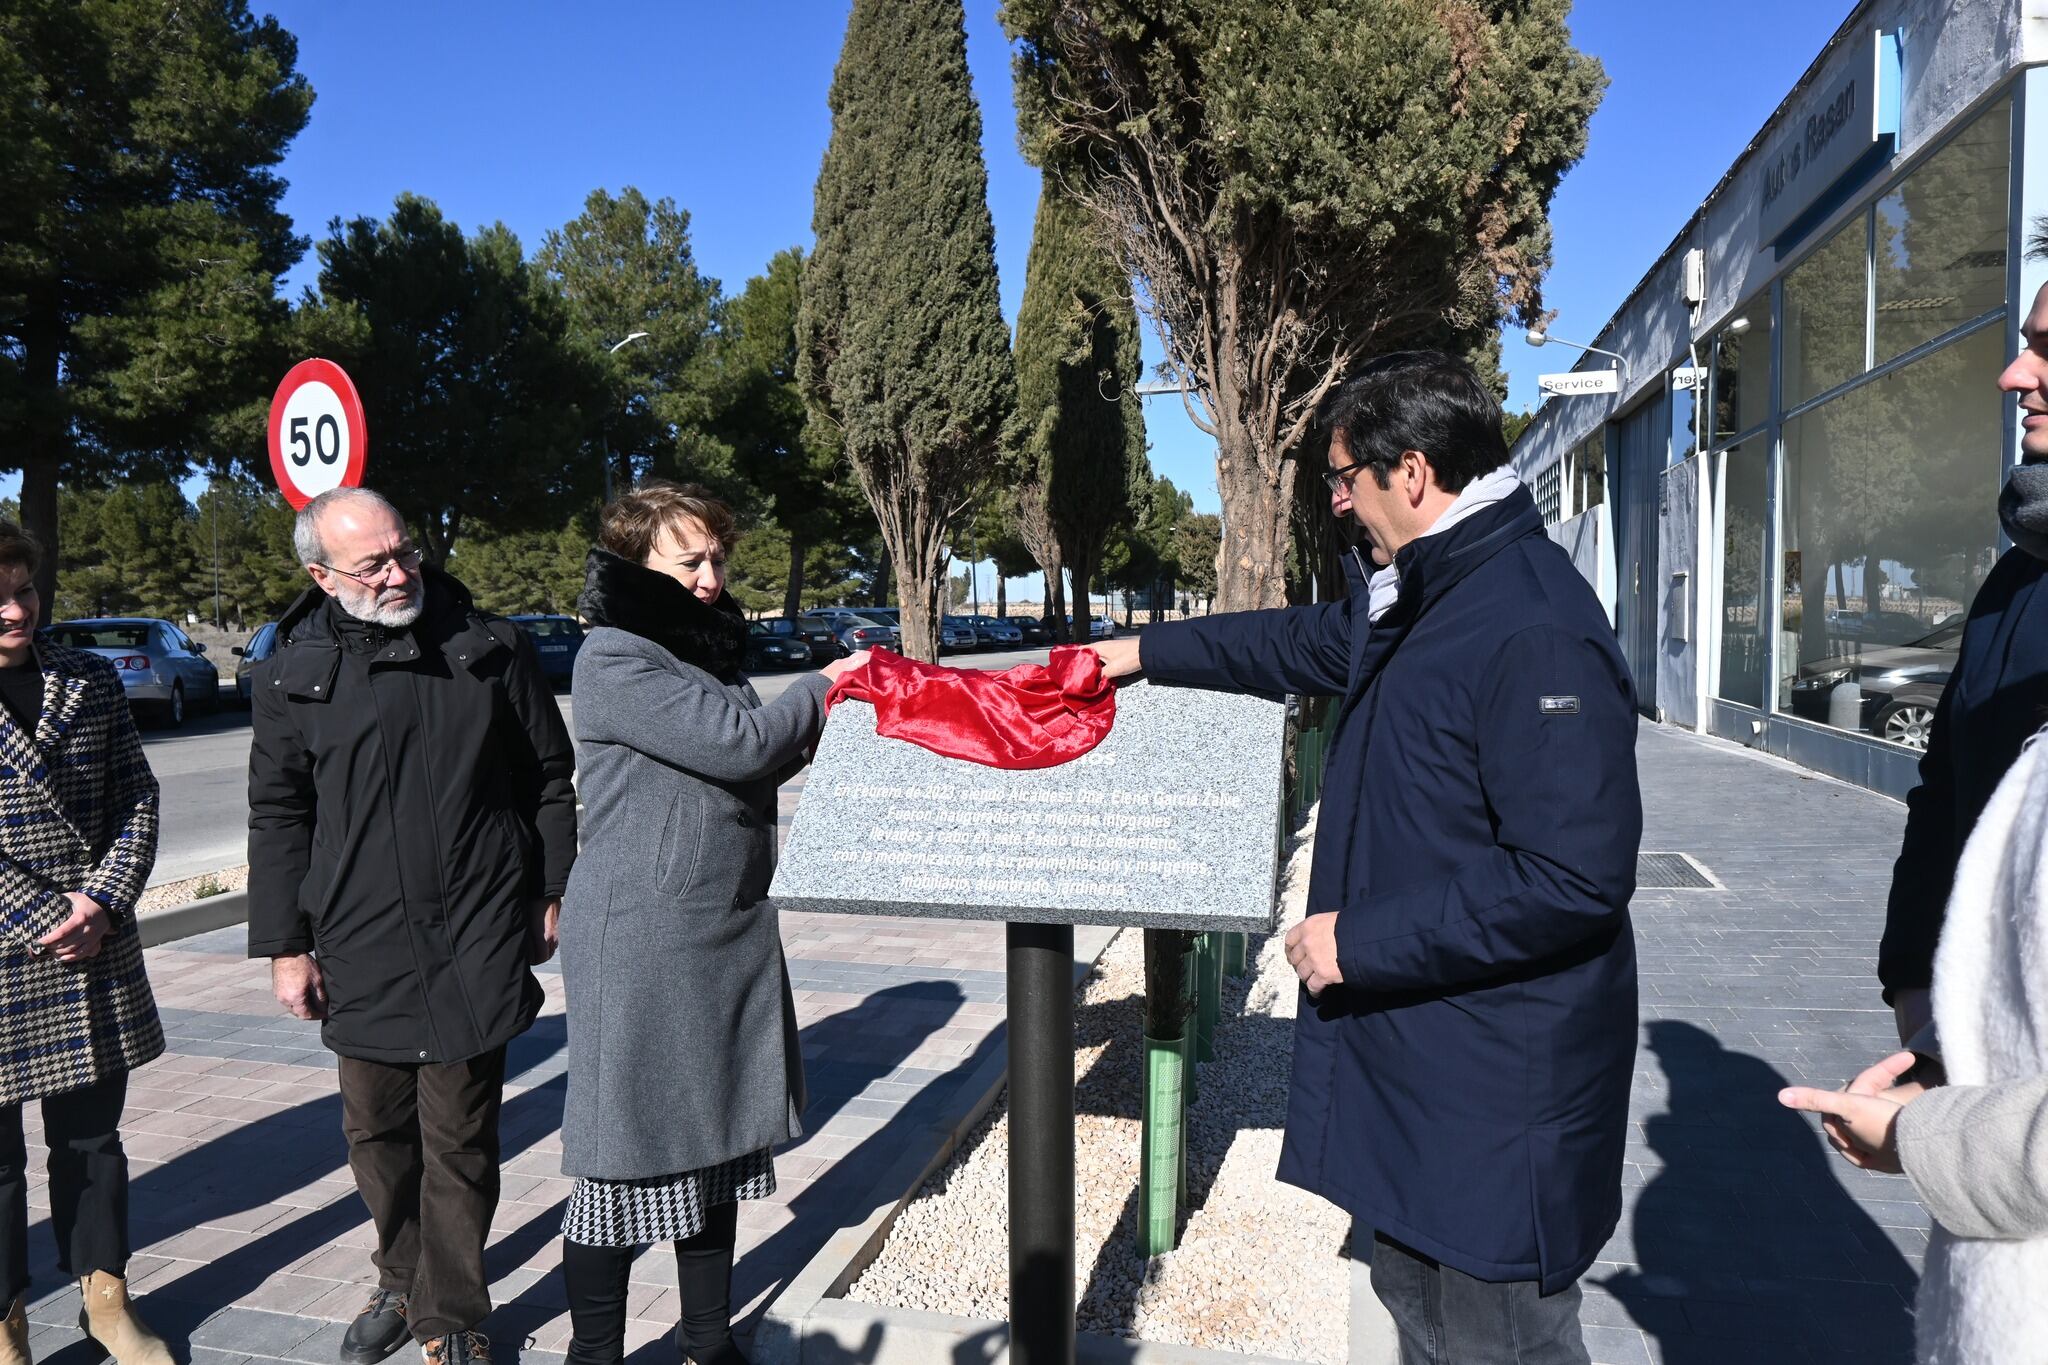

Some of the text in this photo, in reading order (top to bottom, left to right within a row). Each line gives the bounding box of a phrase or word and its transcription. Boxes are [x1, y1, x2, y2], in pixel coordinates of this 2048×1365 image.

[1544, 379, 1604, 391] Service
[290, 413, 340, 467] 50
[834, 783, 850, 797] En
[853, 783, 902, 799] Febrero
[905, 784, 921, 799] de
[960, 787, 1005, 801] siendo
[1009, 787, 1073, 803] Alcaldesa
[1111, 789, 1150, 805] Elena
[887, 806, 1172, 831] Fueron inauguradas las mejoras integrales
[870, 827, 922, 842] llevadas
[925, 831, 934, 842] a
[938, 830, 970, 843] cabo
[973, 832, 990, 844] en
[993, 832, 1021, 845] este
[1024, 831, 1067, 846] Paseo
[1071, 832, 1092, 847] del
[832, 850, 857, 862] con
[861, 850, 873, 863] la
[976, 852, 993, 867] de
[998, 856, 1016, 867] su
[1123, 860, 1132, 876] y
